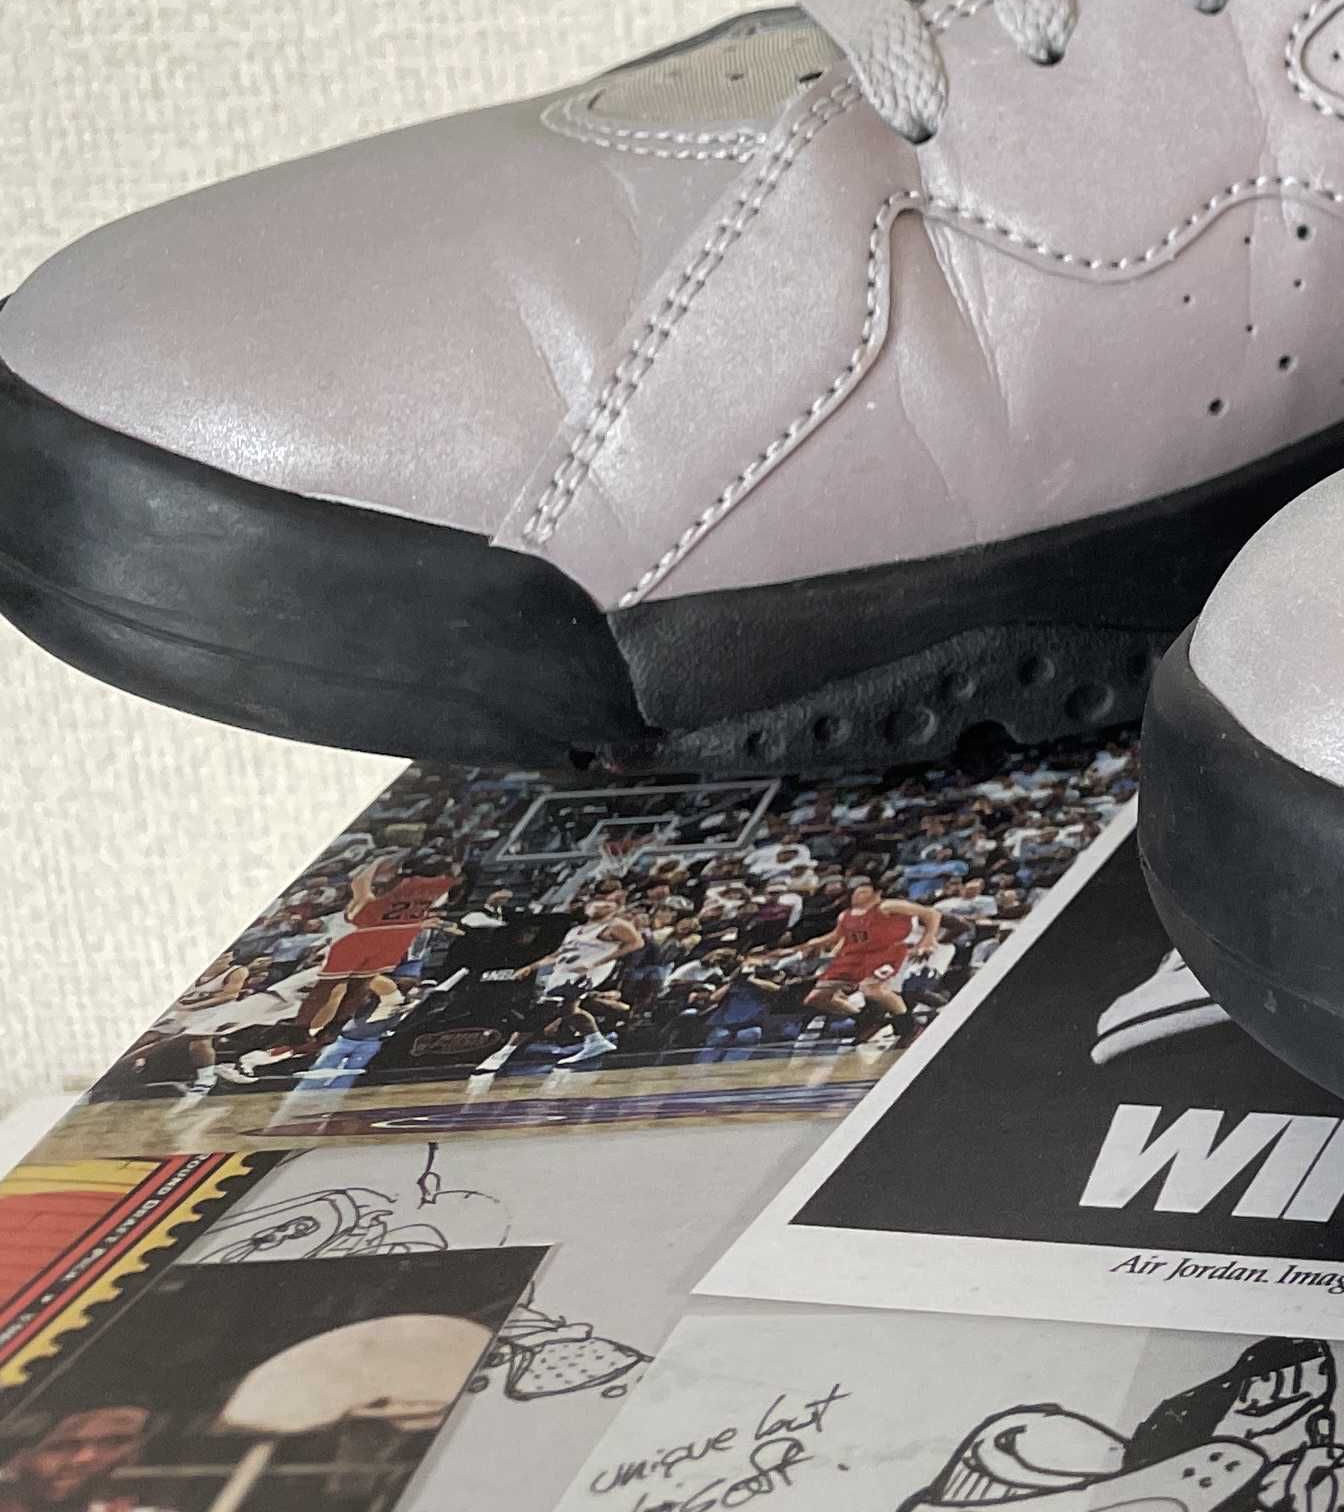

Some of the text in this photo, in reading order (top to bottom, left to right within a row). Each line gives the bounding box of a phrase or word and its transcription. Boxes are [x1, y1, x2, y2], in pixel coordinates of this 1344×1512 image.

[1110, 1254, 1166, 1274] Air
[590, 1383, 852, 1493] unique but
